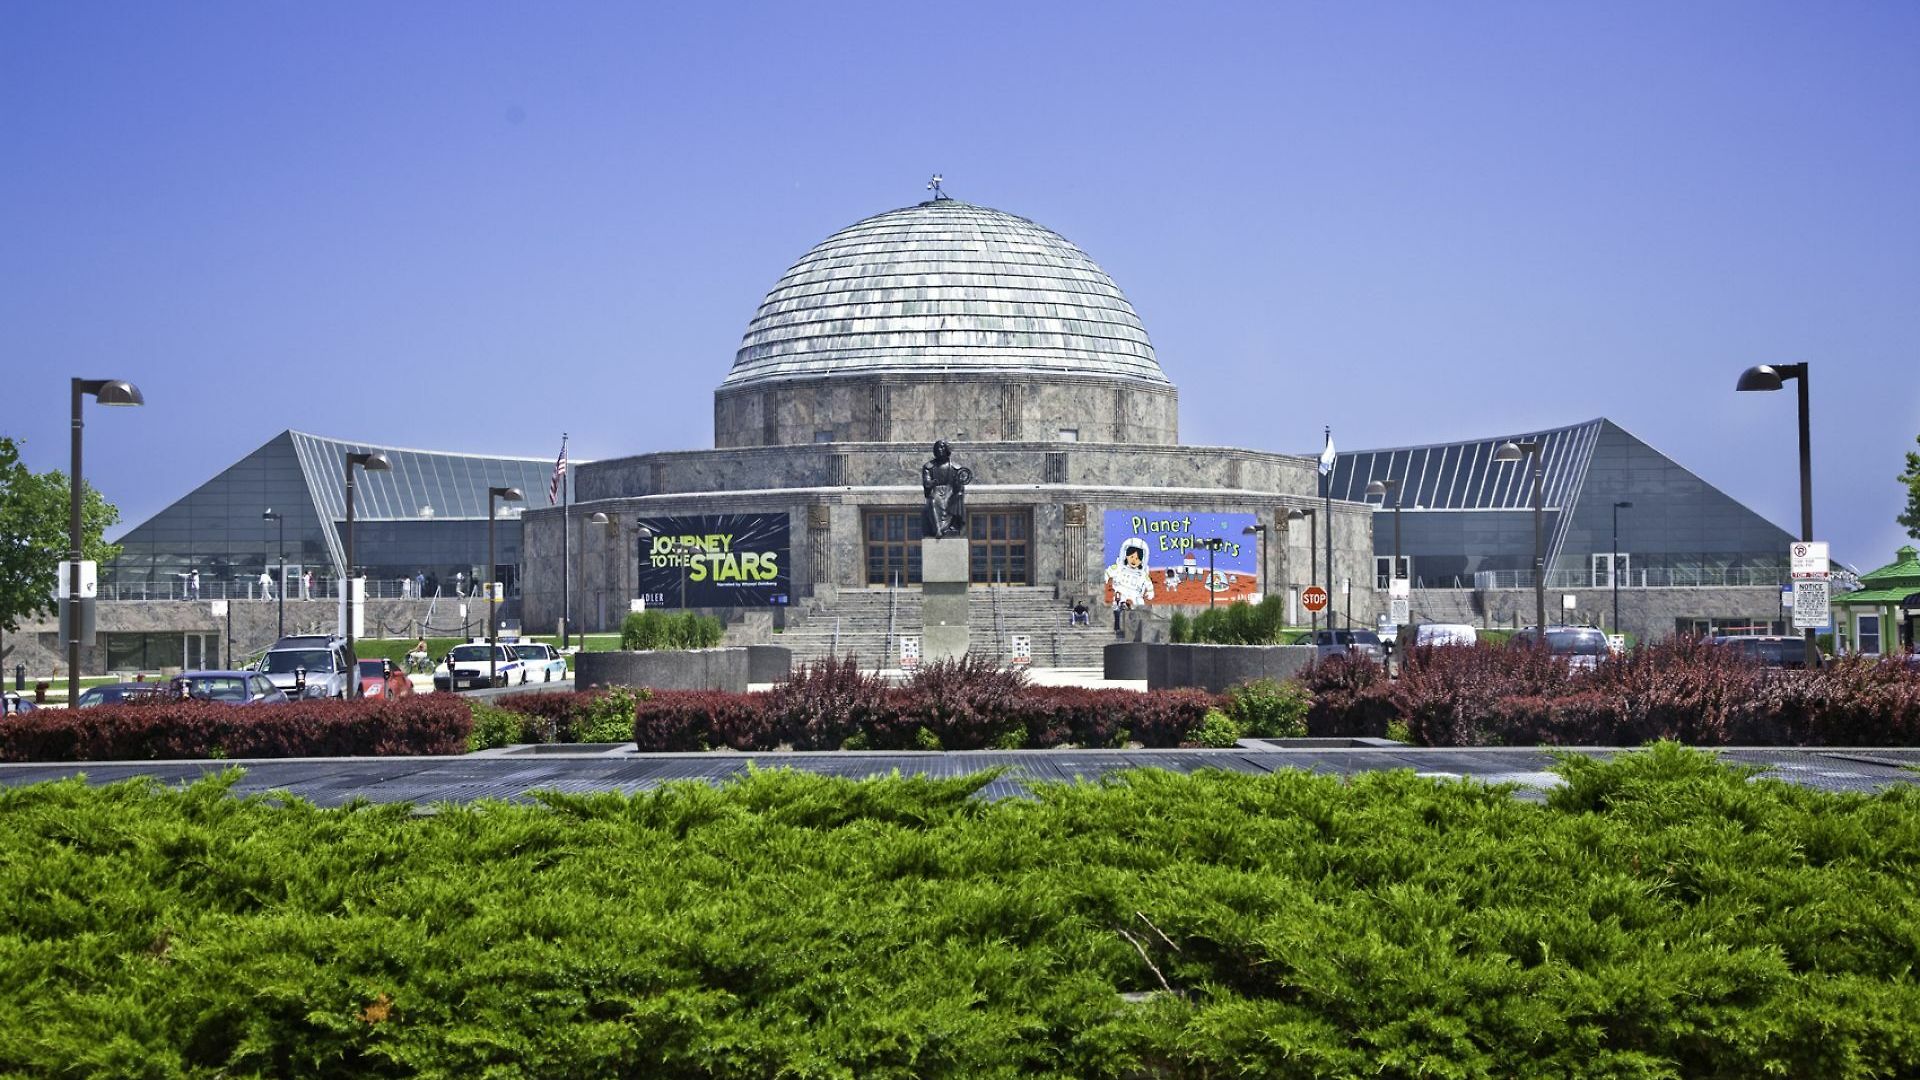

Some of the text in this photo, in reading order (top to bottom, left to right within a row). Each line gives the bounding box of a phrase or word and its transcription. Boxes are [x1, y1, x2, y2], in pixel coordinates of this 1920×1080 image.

[1132, 516, 1192, 534] Planet
[650, 551, 778, 582] TO THE STARS
[1303, 593, 1326, 604] STOP
